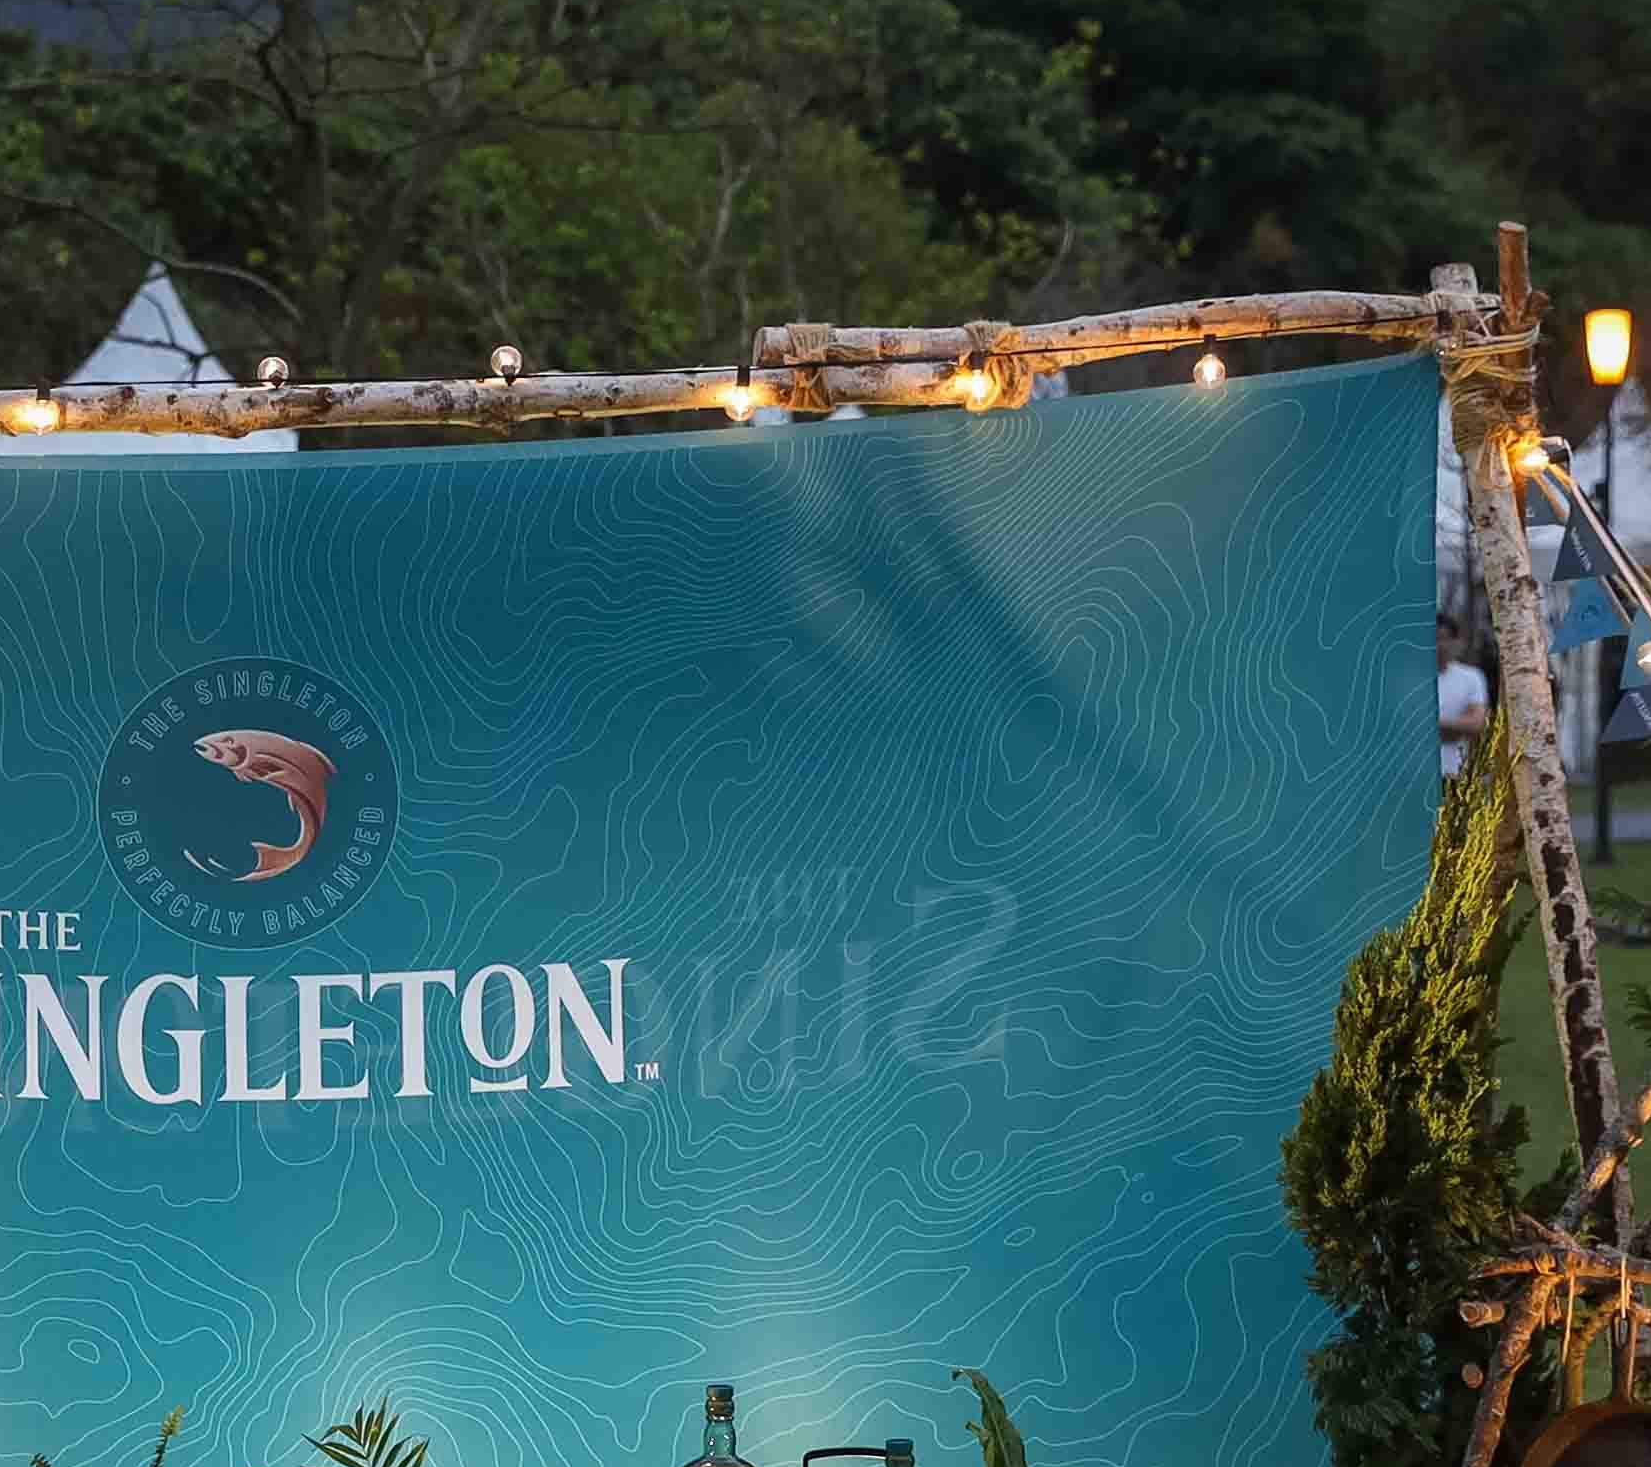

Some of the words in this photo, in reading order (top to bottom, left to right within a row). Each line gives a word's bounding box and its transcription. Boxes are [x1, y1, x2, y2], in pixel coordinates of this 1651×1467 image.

[129, 696, 185, 752] THE
[193, 669, 369, 750] SINGLETON
[111, 809, 245, 936] PERFECTLY
[262, 806, 385, 935] BALANCED
